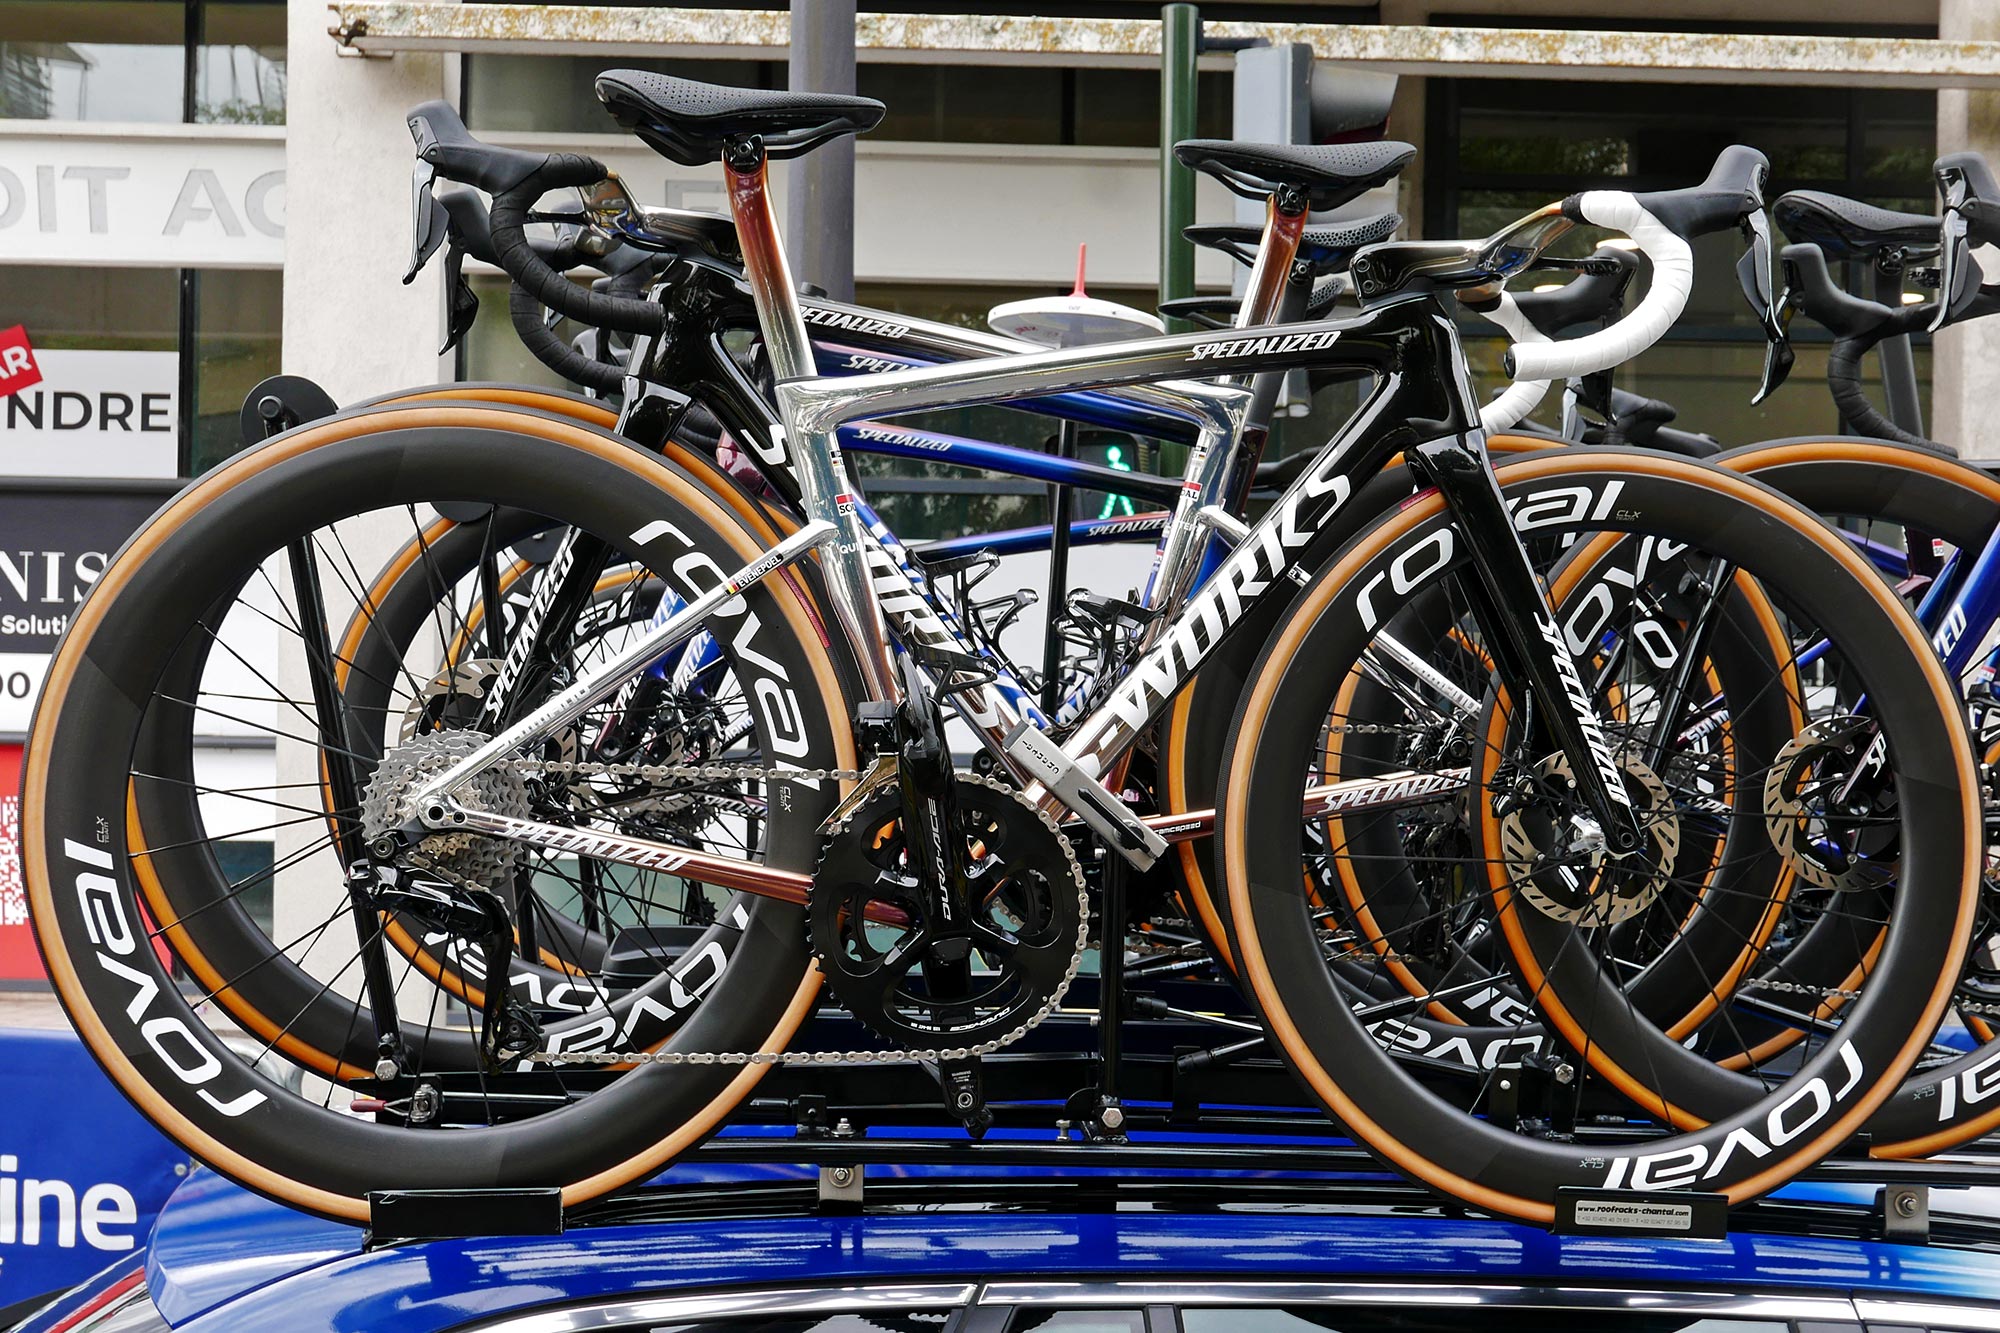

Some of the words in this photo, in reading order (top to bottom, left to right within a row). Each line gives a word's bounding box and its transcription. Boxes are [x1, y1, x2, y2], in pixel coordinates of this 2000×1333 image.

[1185, 331, 1341, 361] SPECIALIZED
[6, 391, 172, 431] NDRE
[853, 428, 953, 452] SPECIALIZED
[738, 555, 782, 588] EVENEPOEL
[485, 546, 575, 725] SPECIALIZED
[629, 519, 821, 792] roval
[1533, 611, 1631, 808] SPECIALIZED
[1317, 767, 1471, 814] SPECIALIZED
[494, 821, 691, 871] SPECIALIZED
[928, 797, 951, 921] DURA-ACE
[63, 838, 269, 1117] roval
[1601, 1039, 1865, 1191] roval
[1577, 1205, 1689, 1217] www.roofracks-chantal.com
